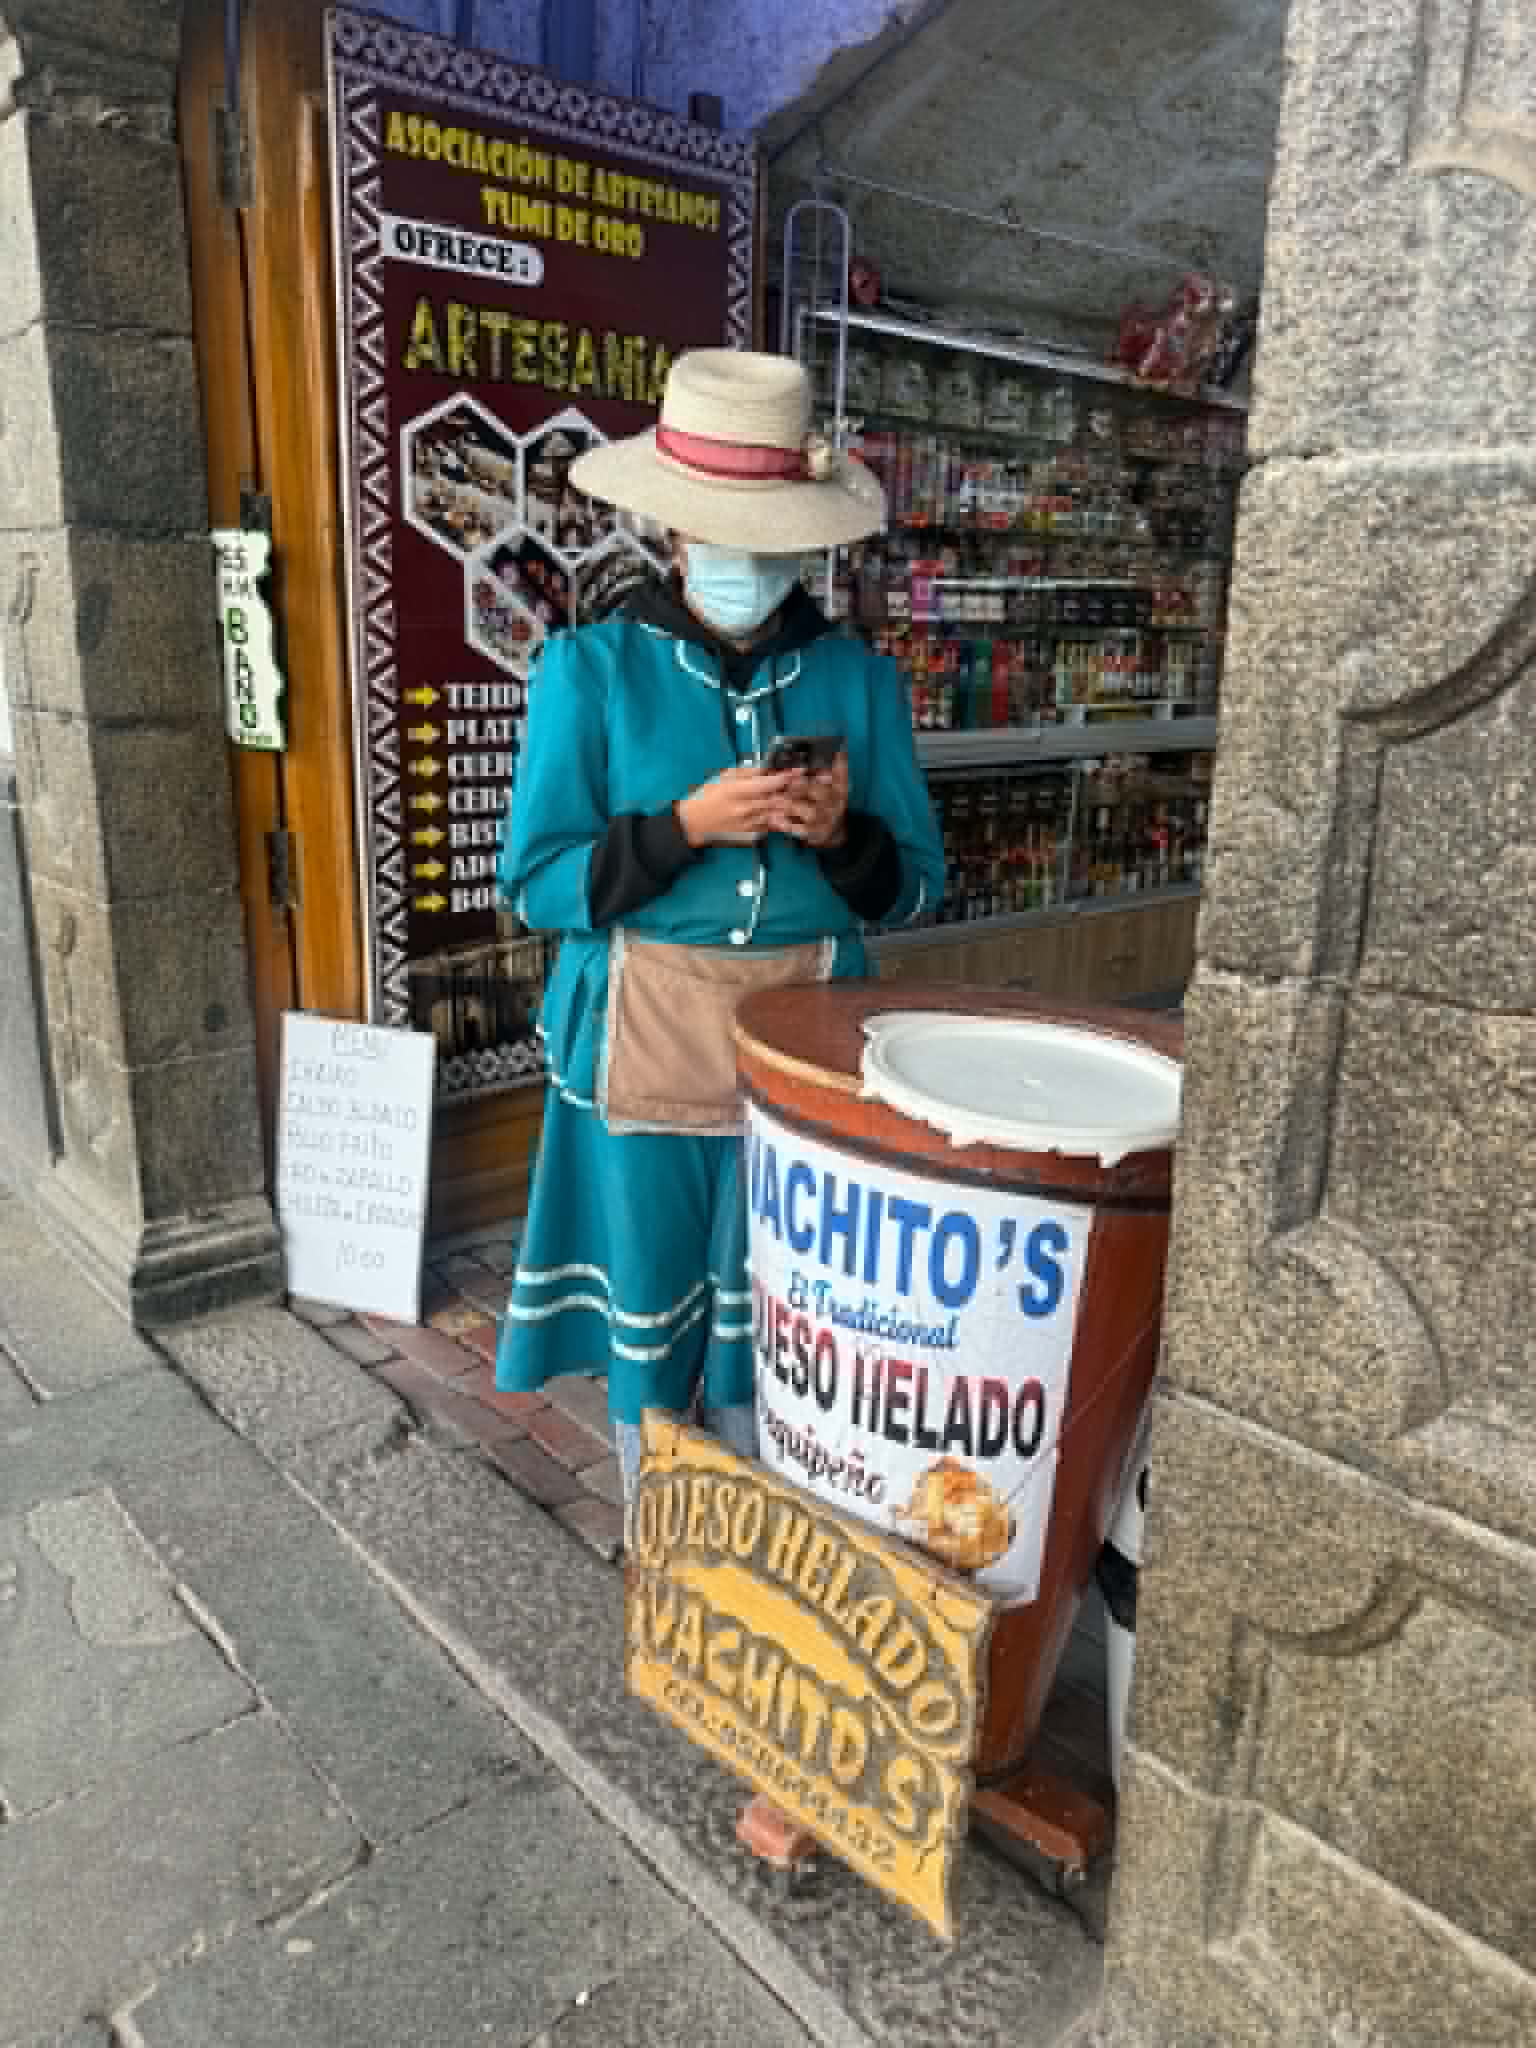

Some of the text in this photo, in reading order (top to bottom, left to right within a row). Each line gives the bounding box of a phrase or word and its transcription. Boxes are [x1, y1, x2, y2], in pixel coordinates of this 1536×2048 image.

[385, 111, 720, 233] ASOCIACIÓN DE ARTESANOS
[481, 185, 644, 259] TUMI DE ORO
[788, 1270, 960, 1351] El Tradicional
[851, 1352, 1046, 1458] HELADO
[636, 1474, 958, 1735] QUESO HELADO
